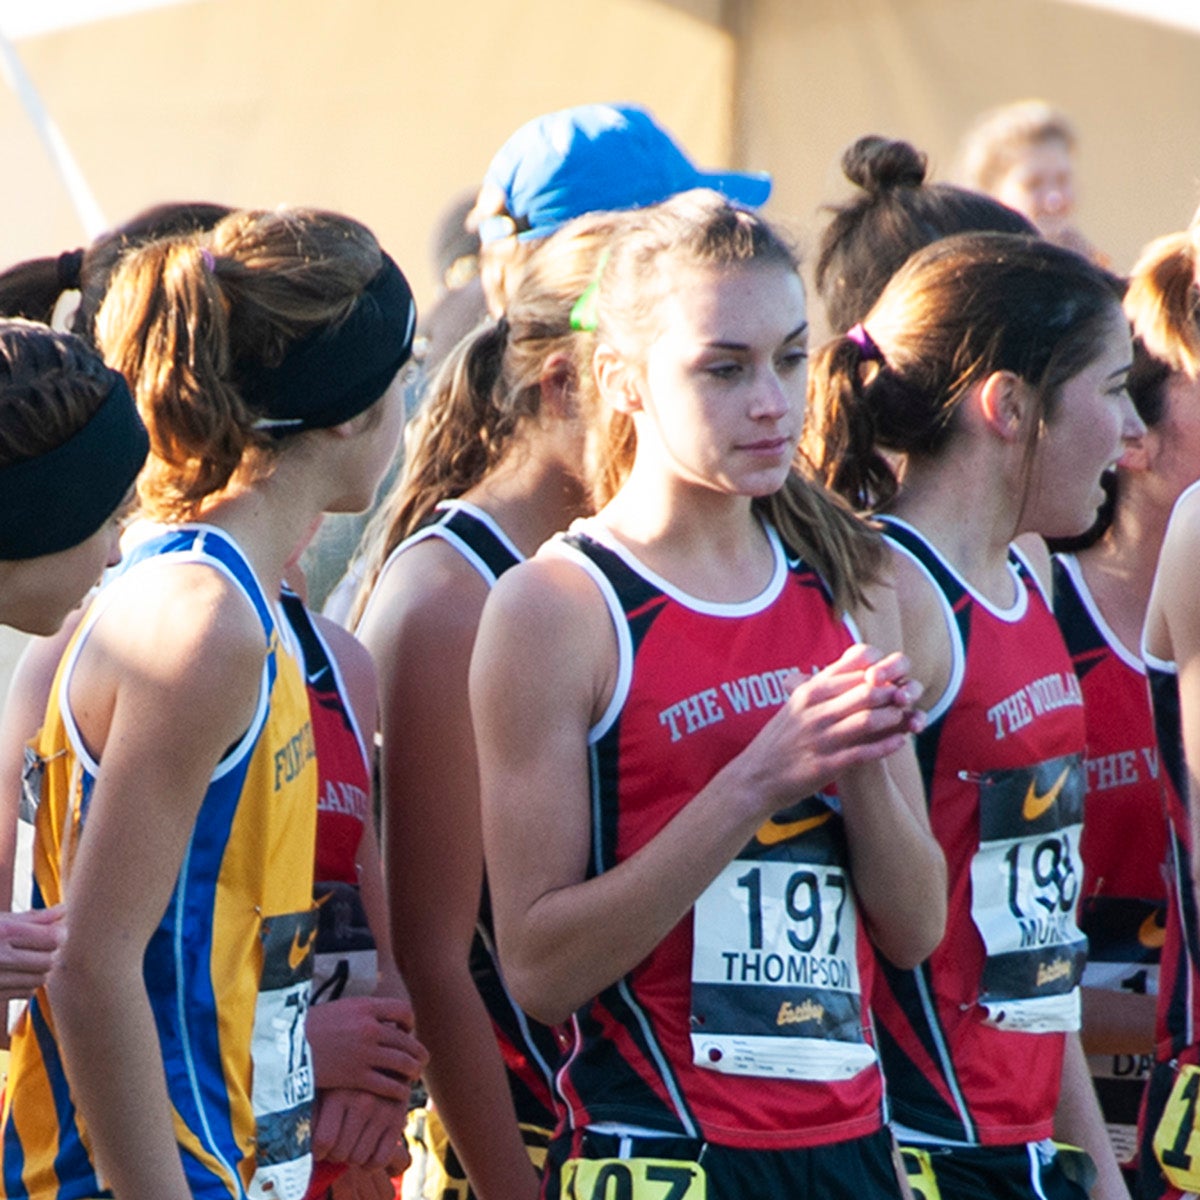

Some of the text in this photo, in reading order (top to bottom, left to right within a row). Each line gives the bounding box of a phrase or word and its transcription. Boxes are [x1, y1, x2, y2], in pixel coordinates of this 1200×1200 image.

[658, 688, 724, 743] THE
[987, 689, 1033, 740] THE
[737, 867, 846, 956] 197
[722, 952, 851, 989] THOMPSON
